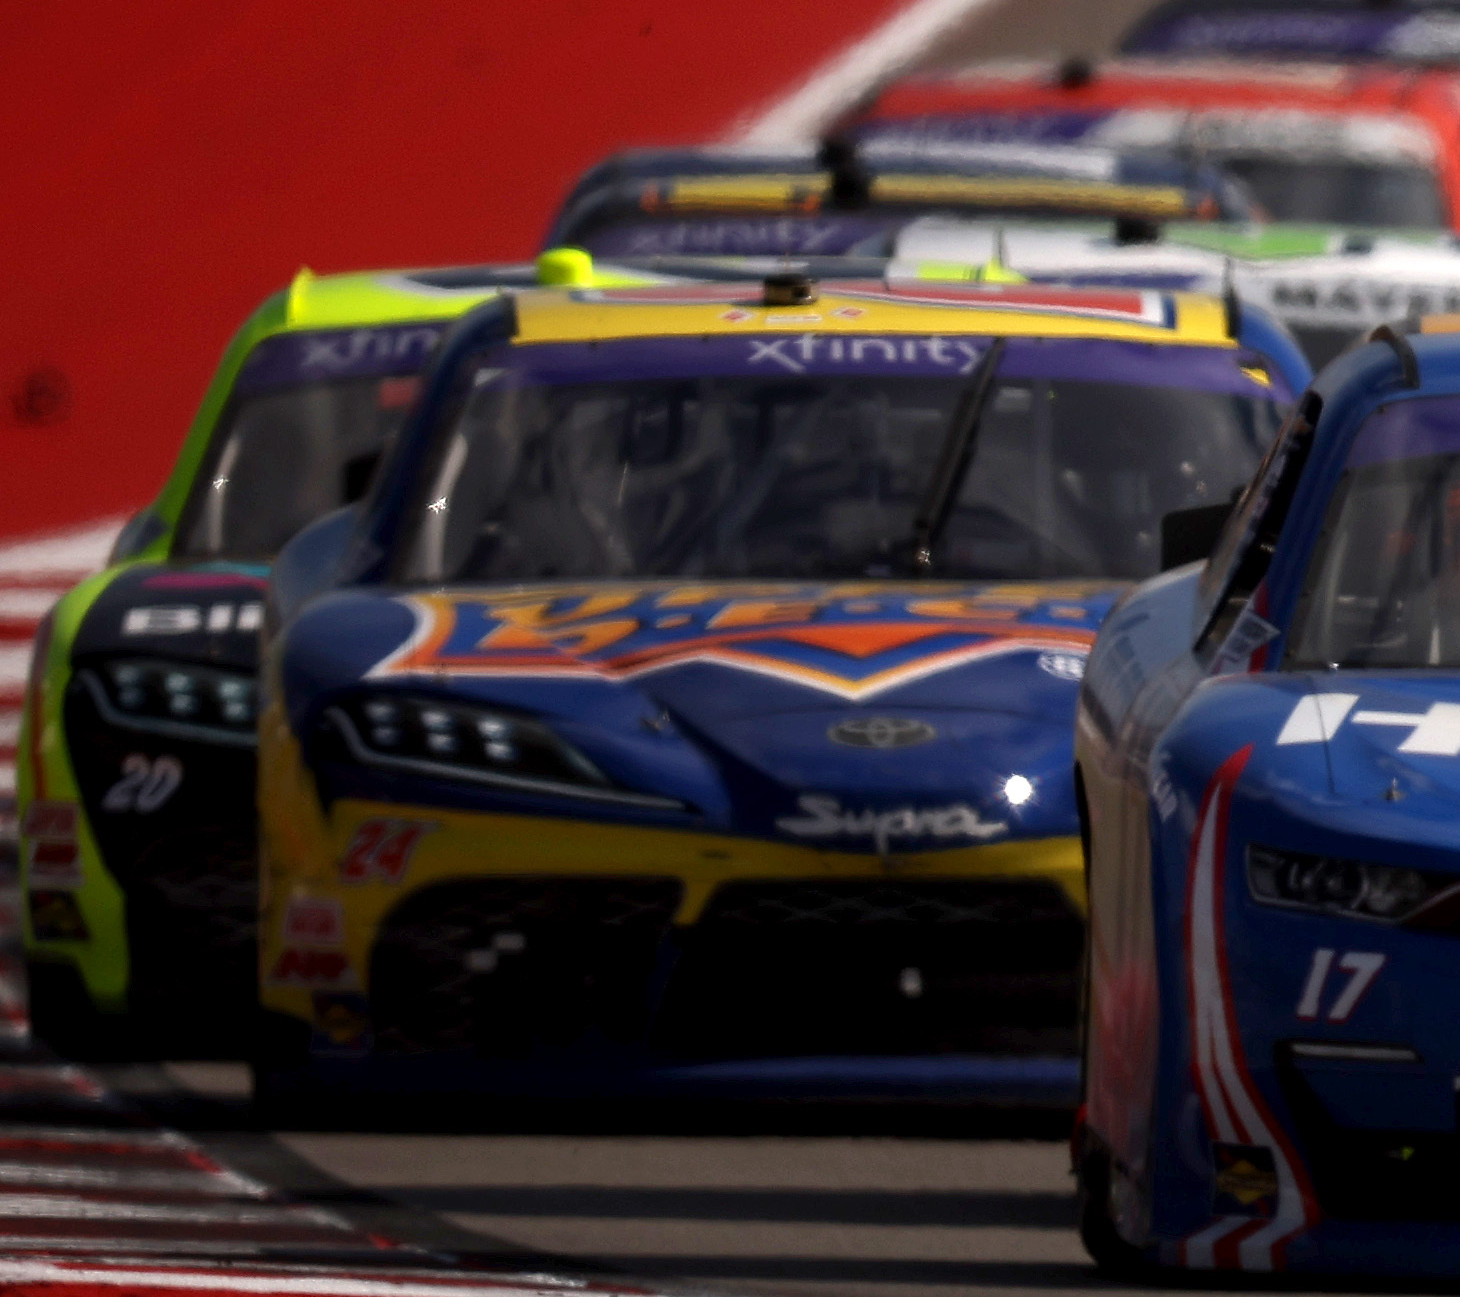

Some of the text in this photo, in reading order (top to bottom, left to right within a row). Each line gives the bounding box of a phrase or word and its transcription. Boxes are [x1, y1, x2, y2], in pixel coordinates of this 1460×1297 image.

[747, 334, 988, 373] xfinity
[102, 751, 184, 814] 20
[340, 817, 436, 886] 24
[776, 795, 1010, 854] Supra
[1296, 948, 1387, 1025] 17
